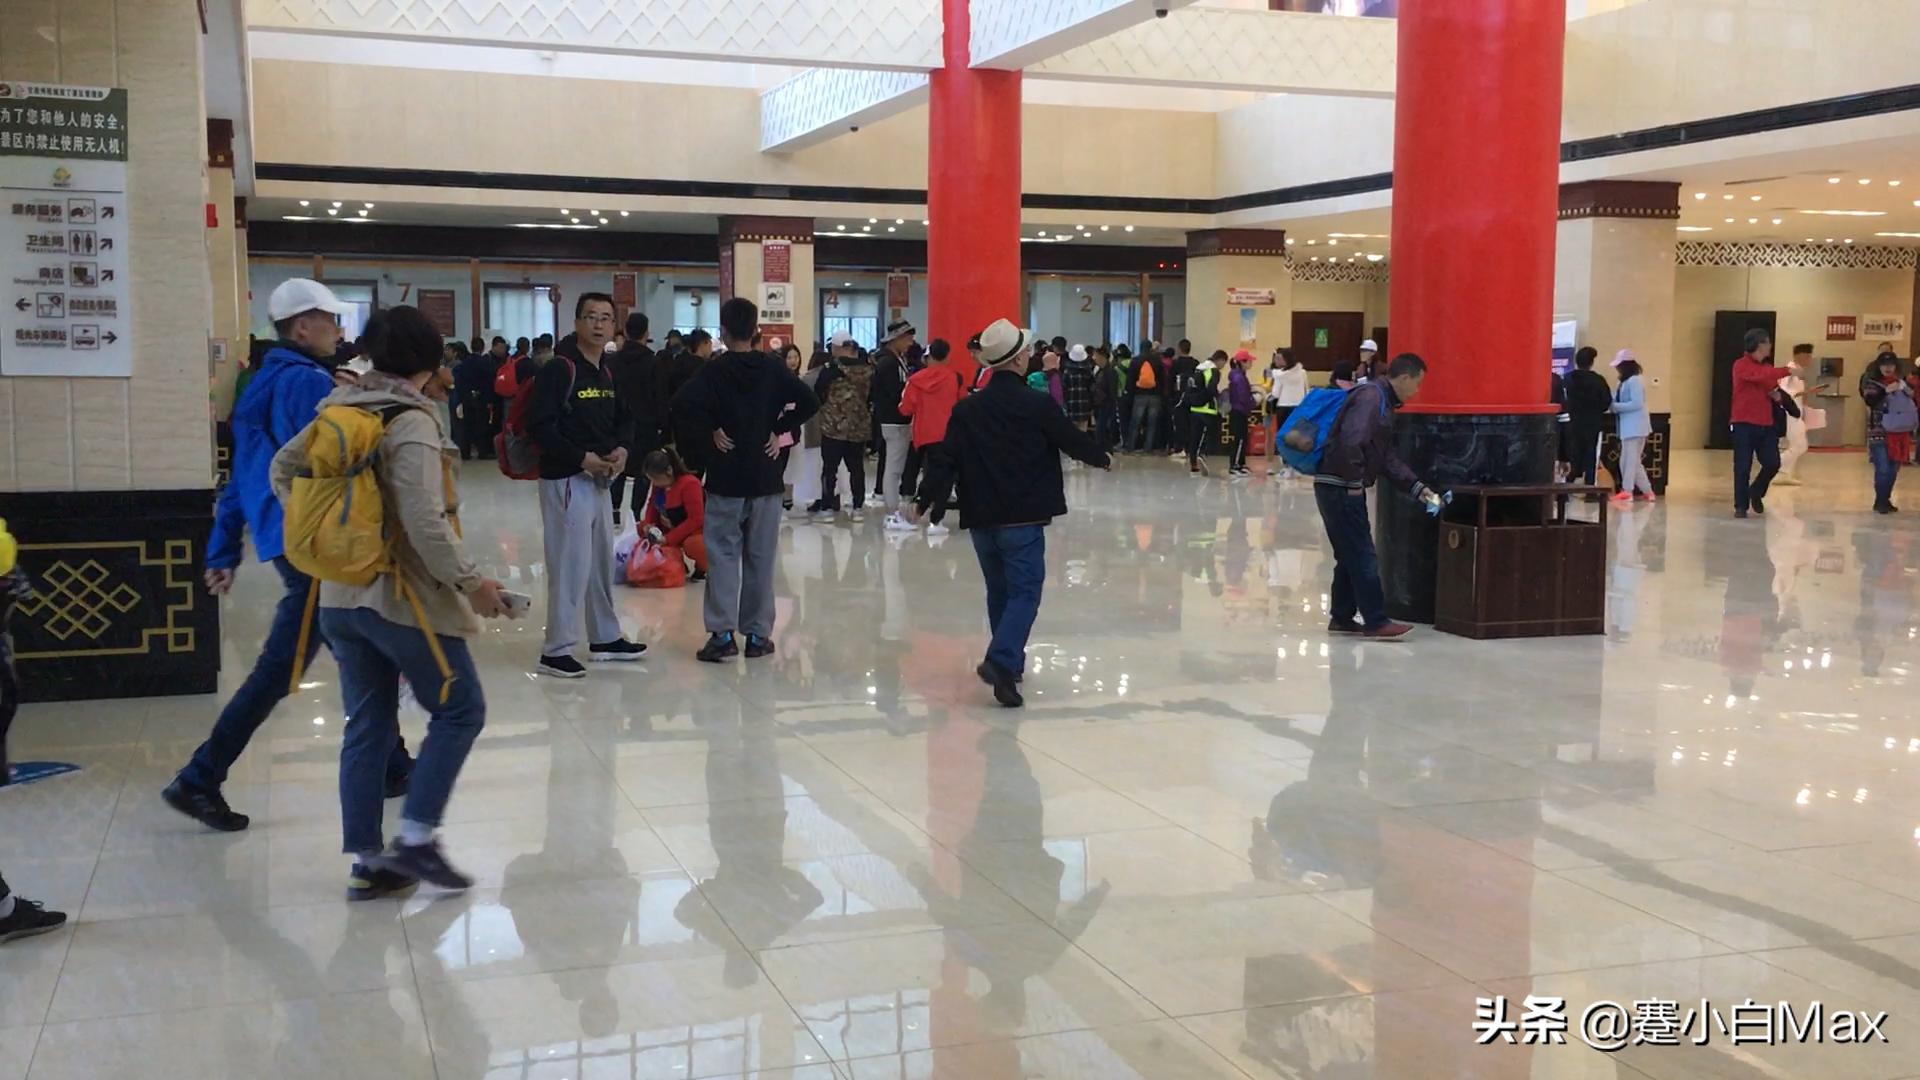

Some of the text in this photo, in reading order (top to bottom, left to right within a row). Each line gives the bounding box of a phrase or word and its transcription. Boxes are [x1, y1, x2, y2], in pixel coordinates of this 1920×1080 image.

[26, 234, 64, 247] 卫生间
[397, 282, 411, 302] 7
[690, 289, 703, 307] 5
[825, 290, 841, 309] 4
[1080, 294, 1092, 312] 2
